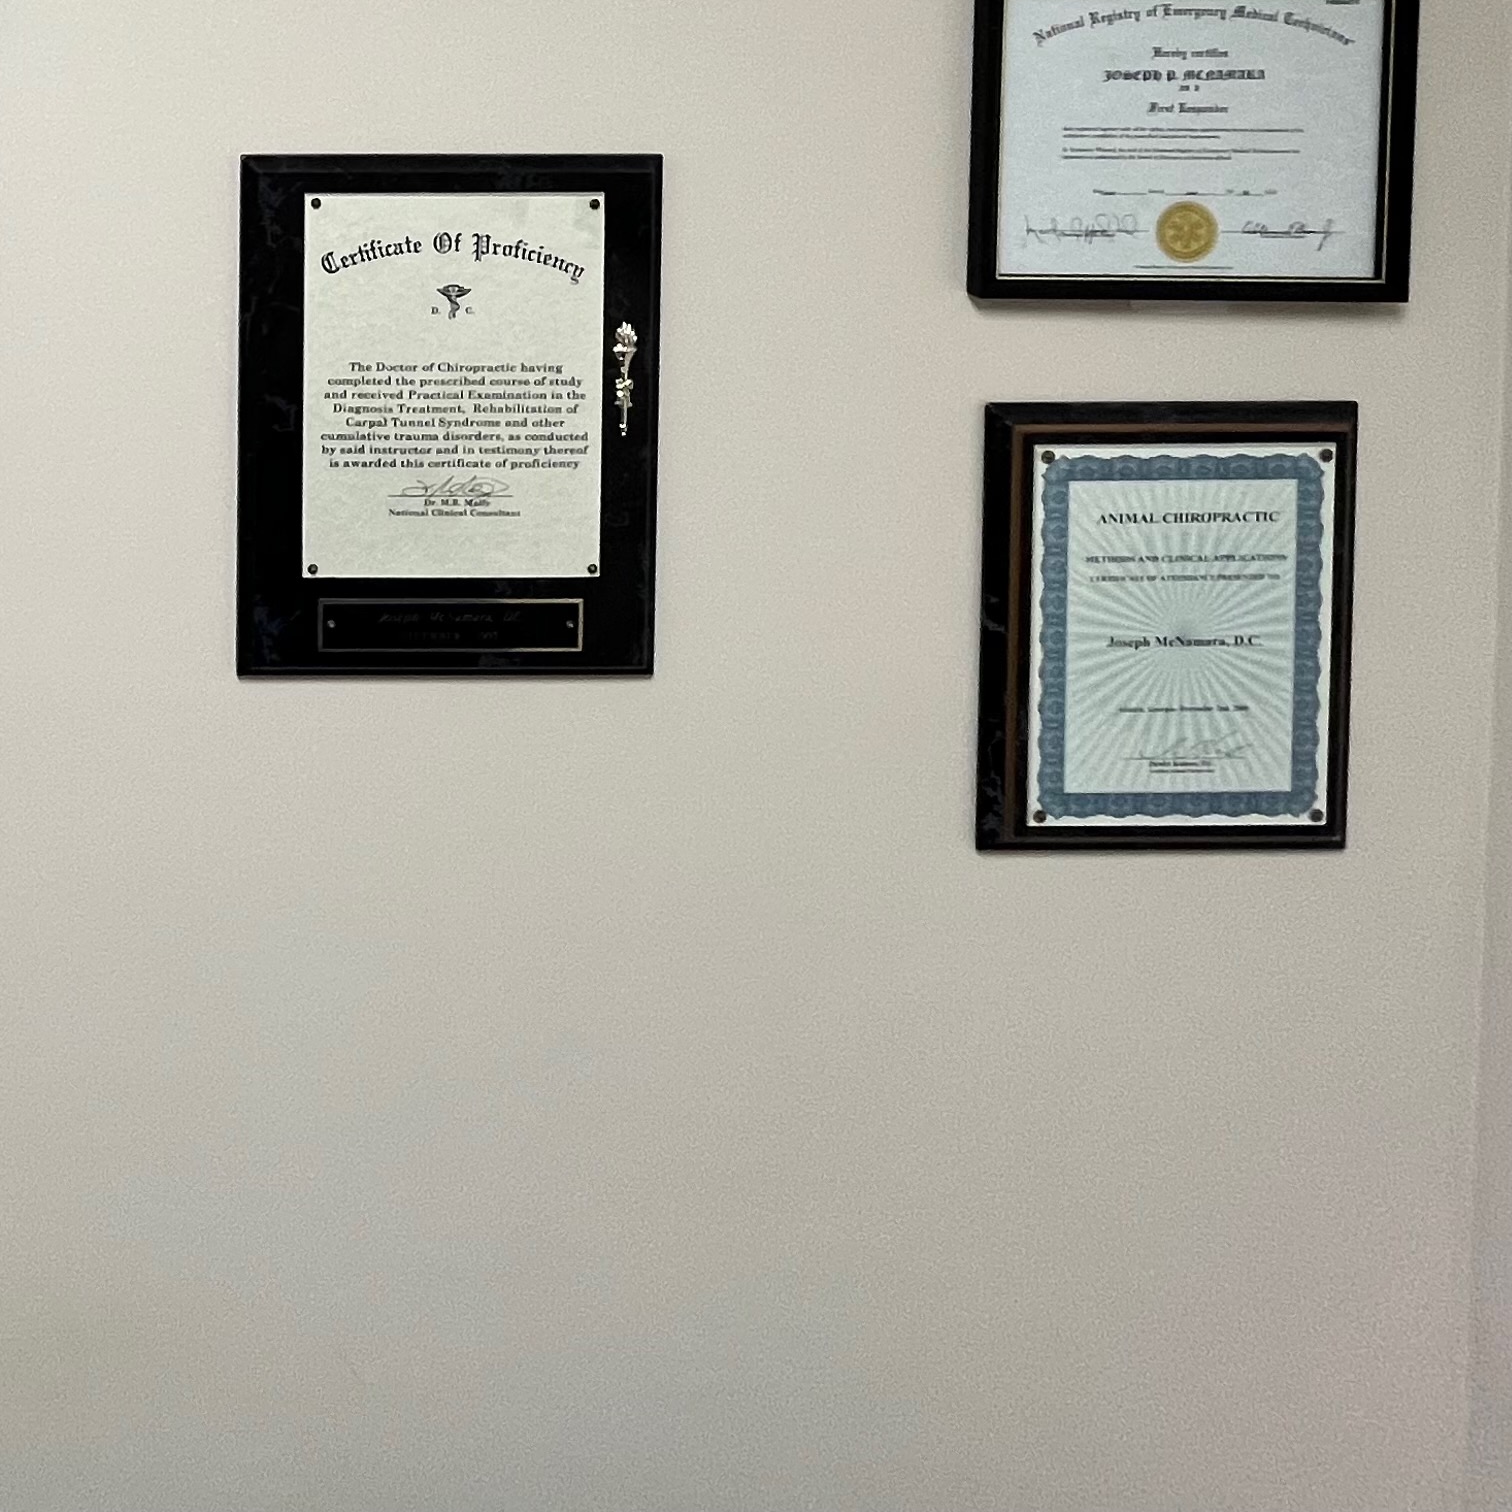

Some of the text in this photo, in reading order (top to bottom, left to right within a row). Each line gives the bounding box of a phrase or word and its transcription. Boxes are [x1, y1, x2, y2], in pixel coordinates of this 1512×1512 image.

[1032, 16, 1085, 47] National
[1089, 9, 1140, 28] Registry
[321, 232, 584, 284] Certificate Of Proficiency
[349, 362, 563, 374] The Doctor of Chiropractic having
[328, 376, 391, 387] completed
[396, 376, 416, 386] the
[420, 376, 485, 388] prescribed
[534, 376, 547, 386] of
[549, 376, 582, 388] study
[324, 390, 586, 400] and received Practical Examination in the
[333, 403, 579, 415] Diagnosis Treatment, Rehabilitation of
[346, 417, 565, 429] Carpal Tunnel Syndrome and other
[321, 431, 390, 441] cumulative
[394, 433, 438, 441] trauma
[443, 431, 504, 441] disorders,
[525, 432, 588, 441] conducted
[322, 444, 589, 456] by said instructor and in testimony thereof
[330, 458, 579, 470] is awarded this certificate of proficiency
[1101, 512, 1280, 524] ANIMAL CHIROPRACTIC
[1107, 636, 1150, 650] Joseph
[1232, 635, 1261, 646] D.C.
